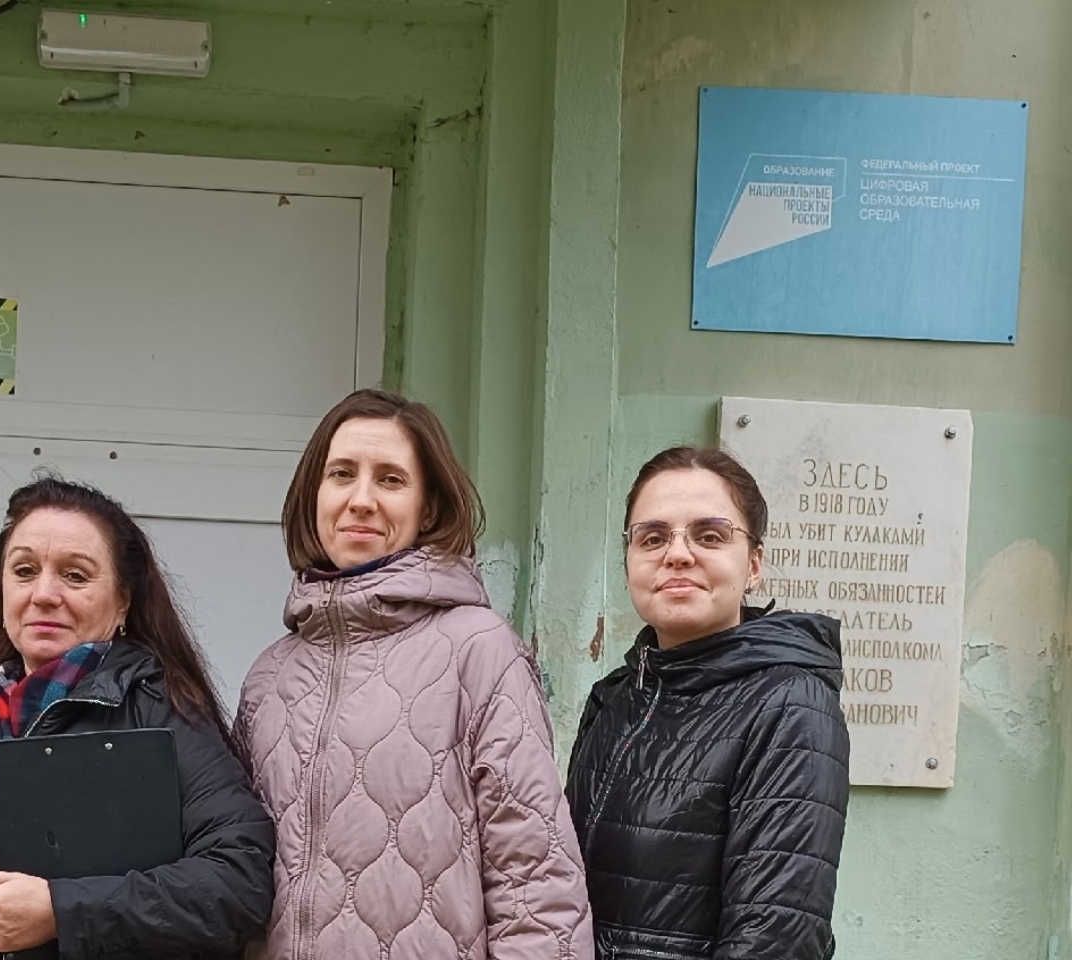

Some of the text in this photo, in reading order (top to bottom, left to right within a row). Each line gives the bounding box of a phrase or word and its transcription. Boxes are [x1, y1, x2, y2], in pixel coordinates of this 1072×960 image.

[763, 165, 835, 177] ОБРАЗОВАНИЕ
[861, 159, 981, 174] ФЕДЕРАЛЬНЫЙ ПРОЕКТ
[748, 184, 831, 200] НАЦИОНАЛЬНЫЕ
[860, 178, 929, 192] ЦИФРОВАЯ
[783, 199, 830, 214] ПРОЕКТЫ
[859, 194, 981, 211] ОБРАЗОВАТЕЛЬНАЯ
[791, 212, 830, 227] РОССИИ
[859, 208, 901, 222] СРЕДА
[802, 458, 888, 491] ЗДЕСЬ
[798, 493, 889, 516] В 1918 ГОДУ
[764, 521, 926, 546] ЫЛ УБИТ КУЛАКАМИ
[771, 548, 909, 573] ПРИ ИСПОЛНЕНИИ
[755, 577, 819, 600] ЖЕБНЫХ
[841, 703, 918, 727] АНОВИЧ
